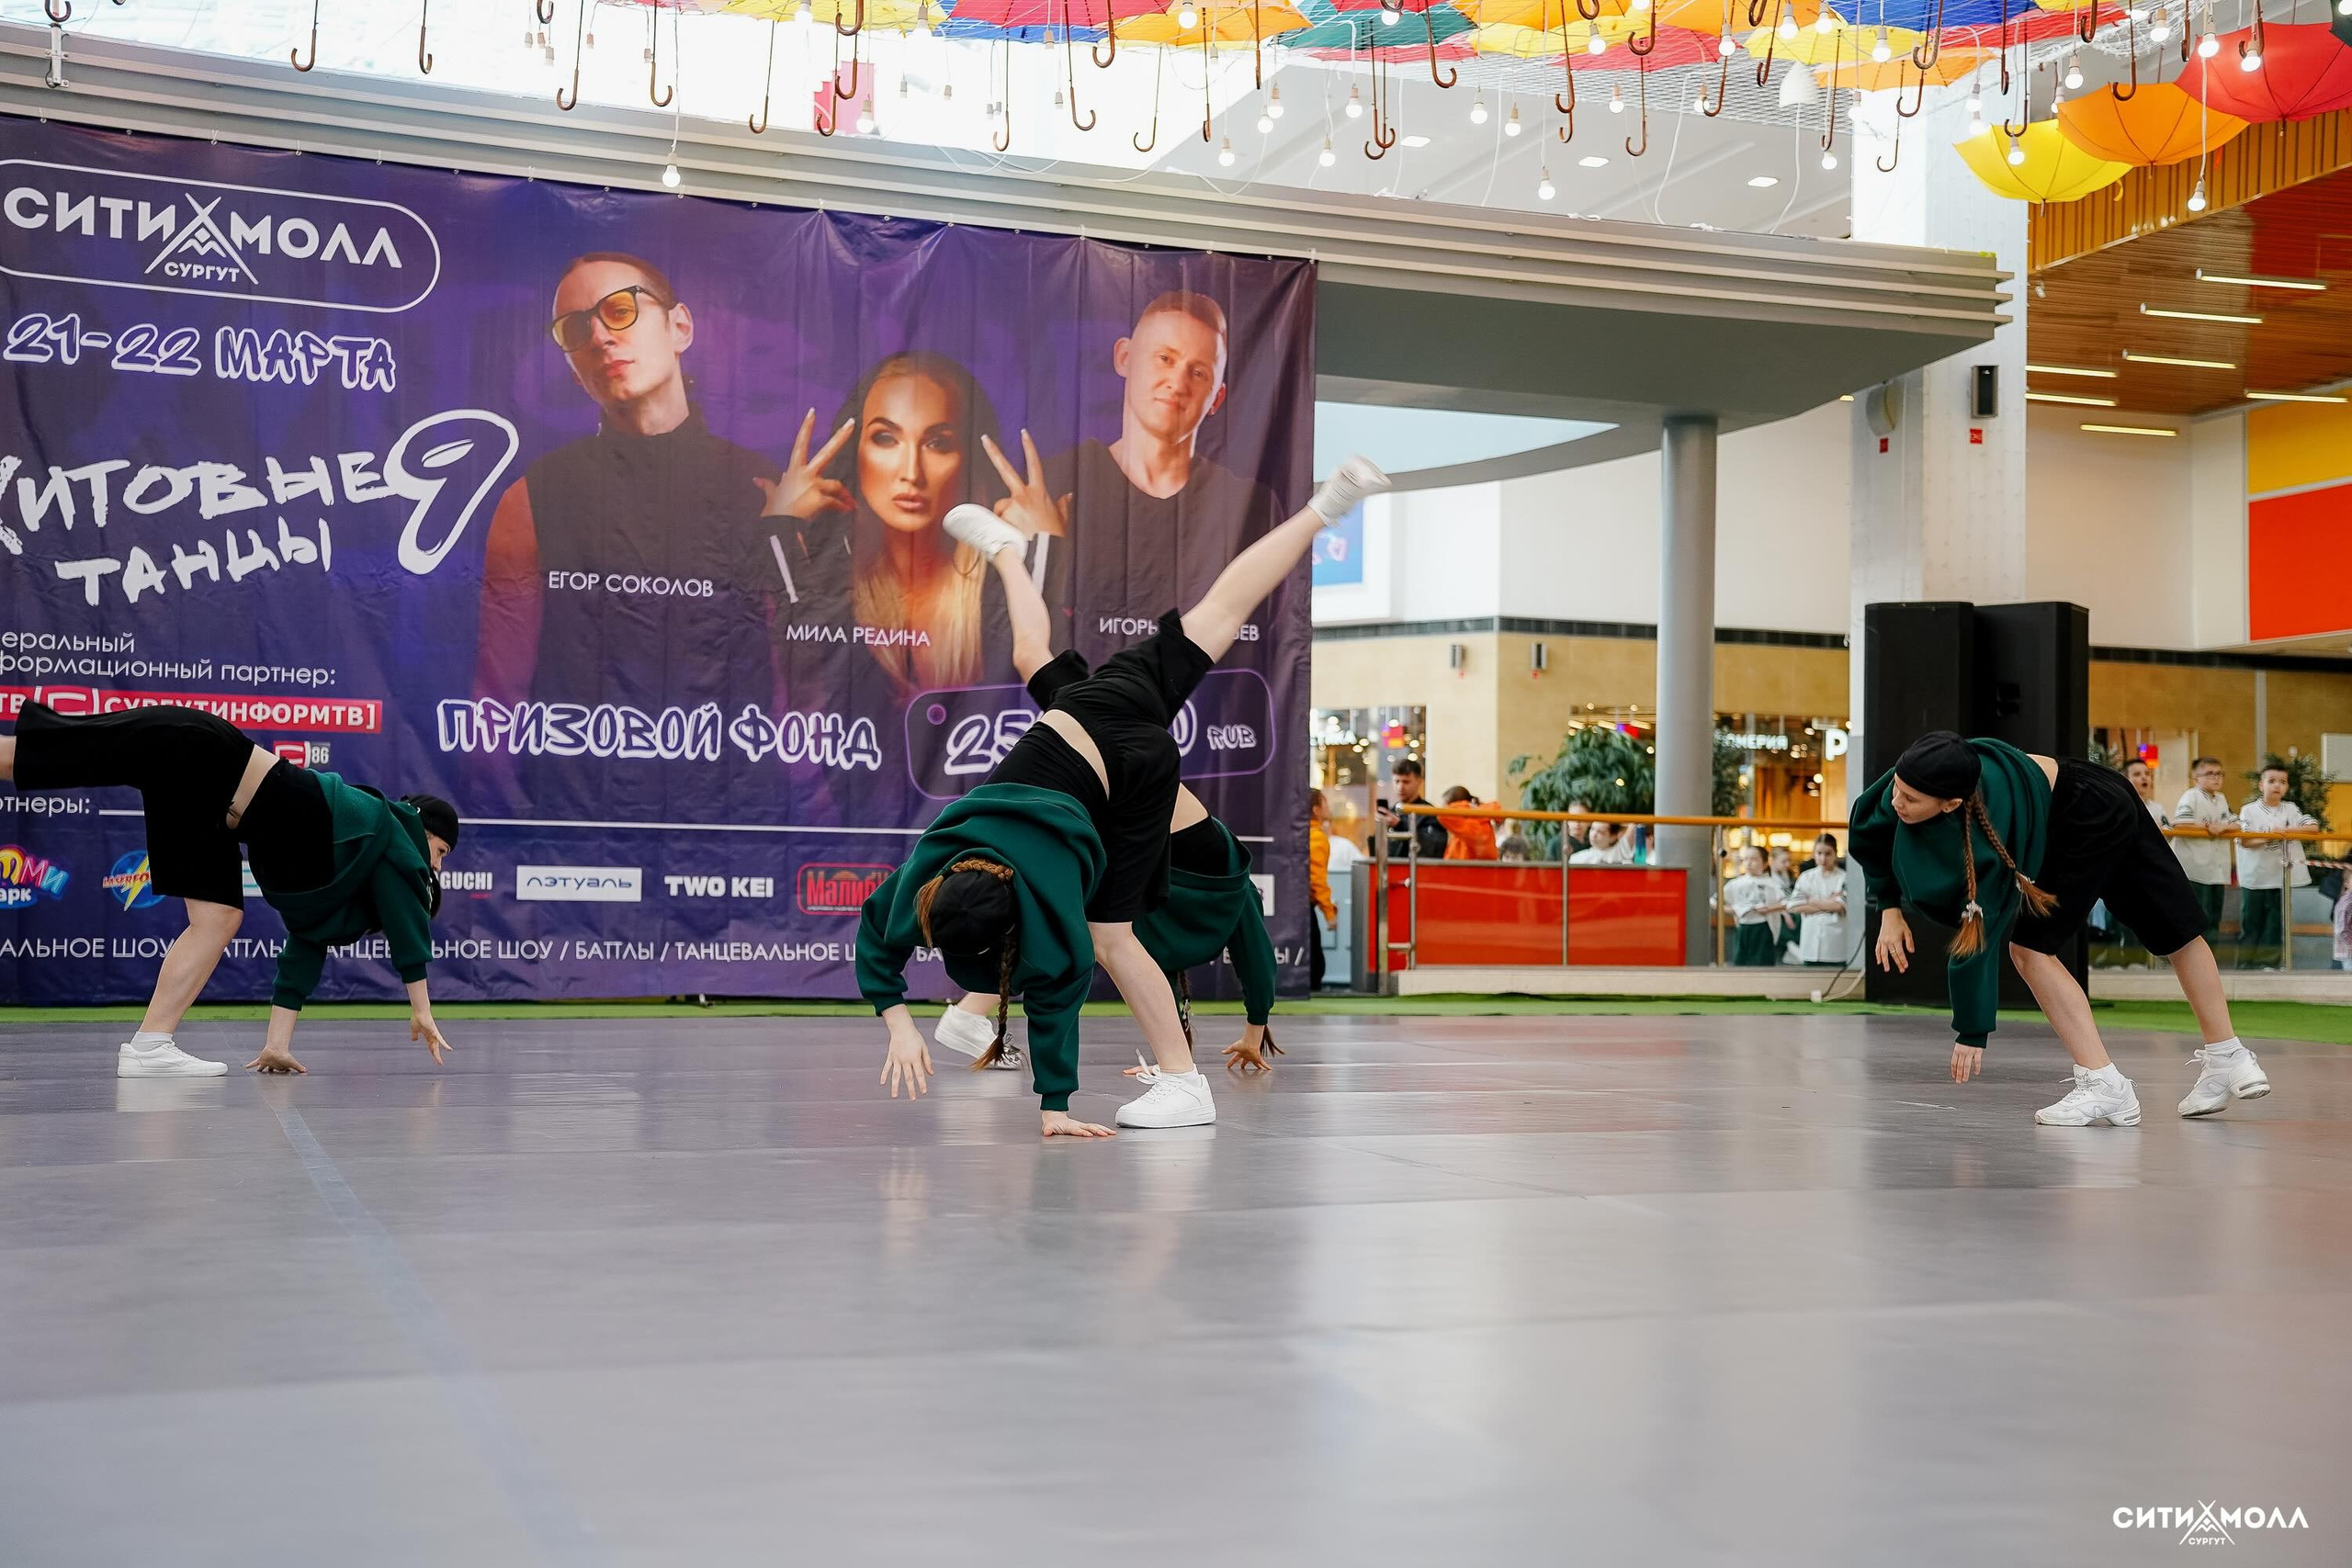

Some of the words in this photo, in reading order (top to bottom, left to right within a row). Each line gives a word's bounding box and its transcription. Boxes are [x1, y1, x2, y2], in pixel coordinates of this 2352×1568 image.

[4, 186, 176, 242] СИТИ
[231, 211, 402, 268] МОЛЛ
[164, 261, 240, 282] СУРГУТ
[3, 313, 201, 376] 21-22
[215, 326, 396, 393] МАРТА
[56, 516, 331, 606] ТАНЦЫ
[548, 570, 600, 591] ЕГОР
[605, 573, 715, 597] СОКОЛОВ
[786, 624, 847, 643] МИЛА
[853, 626, 931, 647] РЕДИНА
[1099, 617, 1159, 636] ИГОРЬ
[221, 664, 335, 688] партнер:
[436, 696, 722, 761] ПРИЗОВОЙ
[729, 703, 881, 771] ФОНД
[1207, 724, 1258, 750] RUB
[0, 795, 90, 818] тнеры:
[434, 870, 493, 890] GUCHI
[664, 875, 726, 897] TWO
[731, 876, 774, 897] KEI
[113, 938, 175, 958] ШОУ
[498, 940, 553, 960] ШОУ
[576, 942, 654, 960] БАТТЛЫ
[674, 942, 840, 963] ТАНЦЕВАЛЬНОЕ
